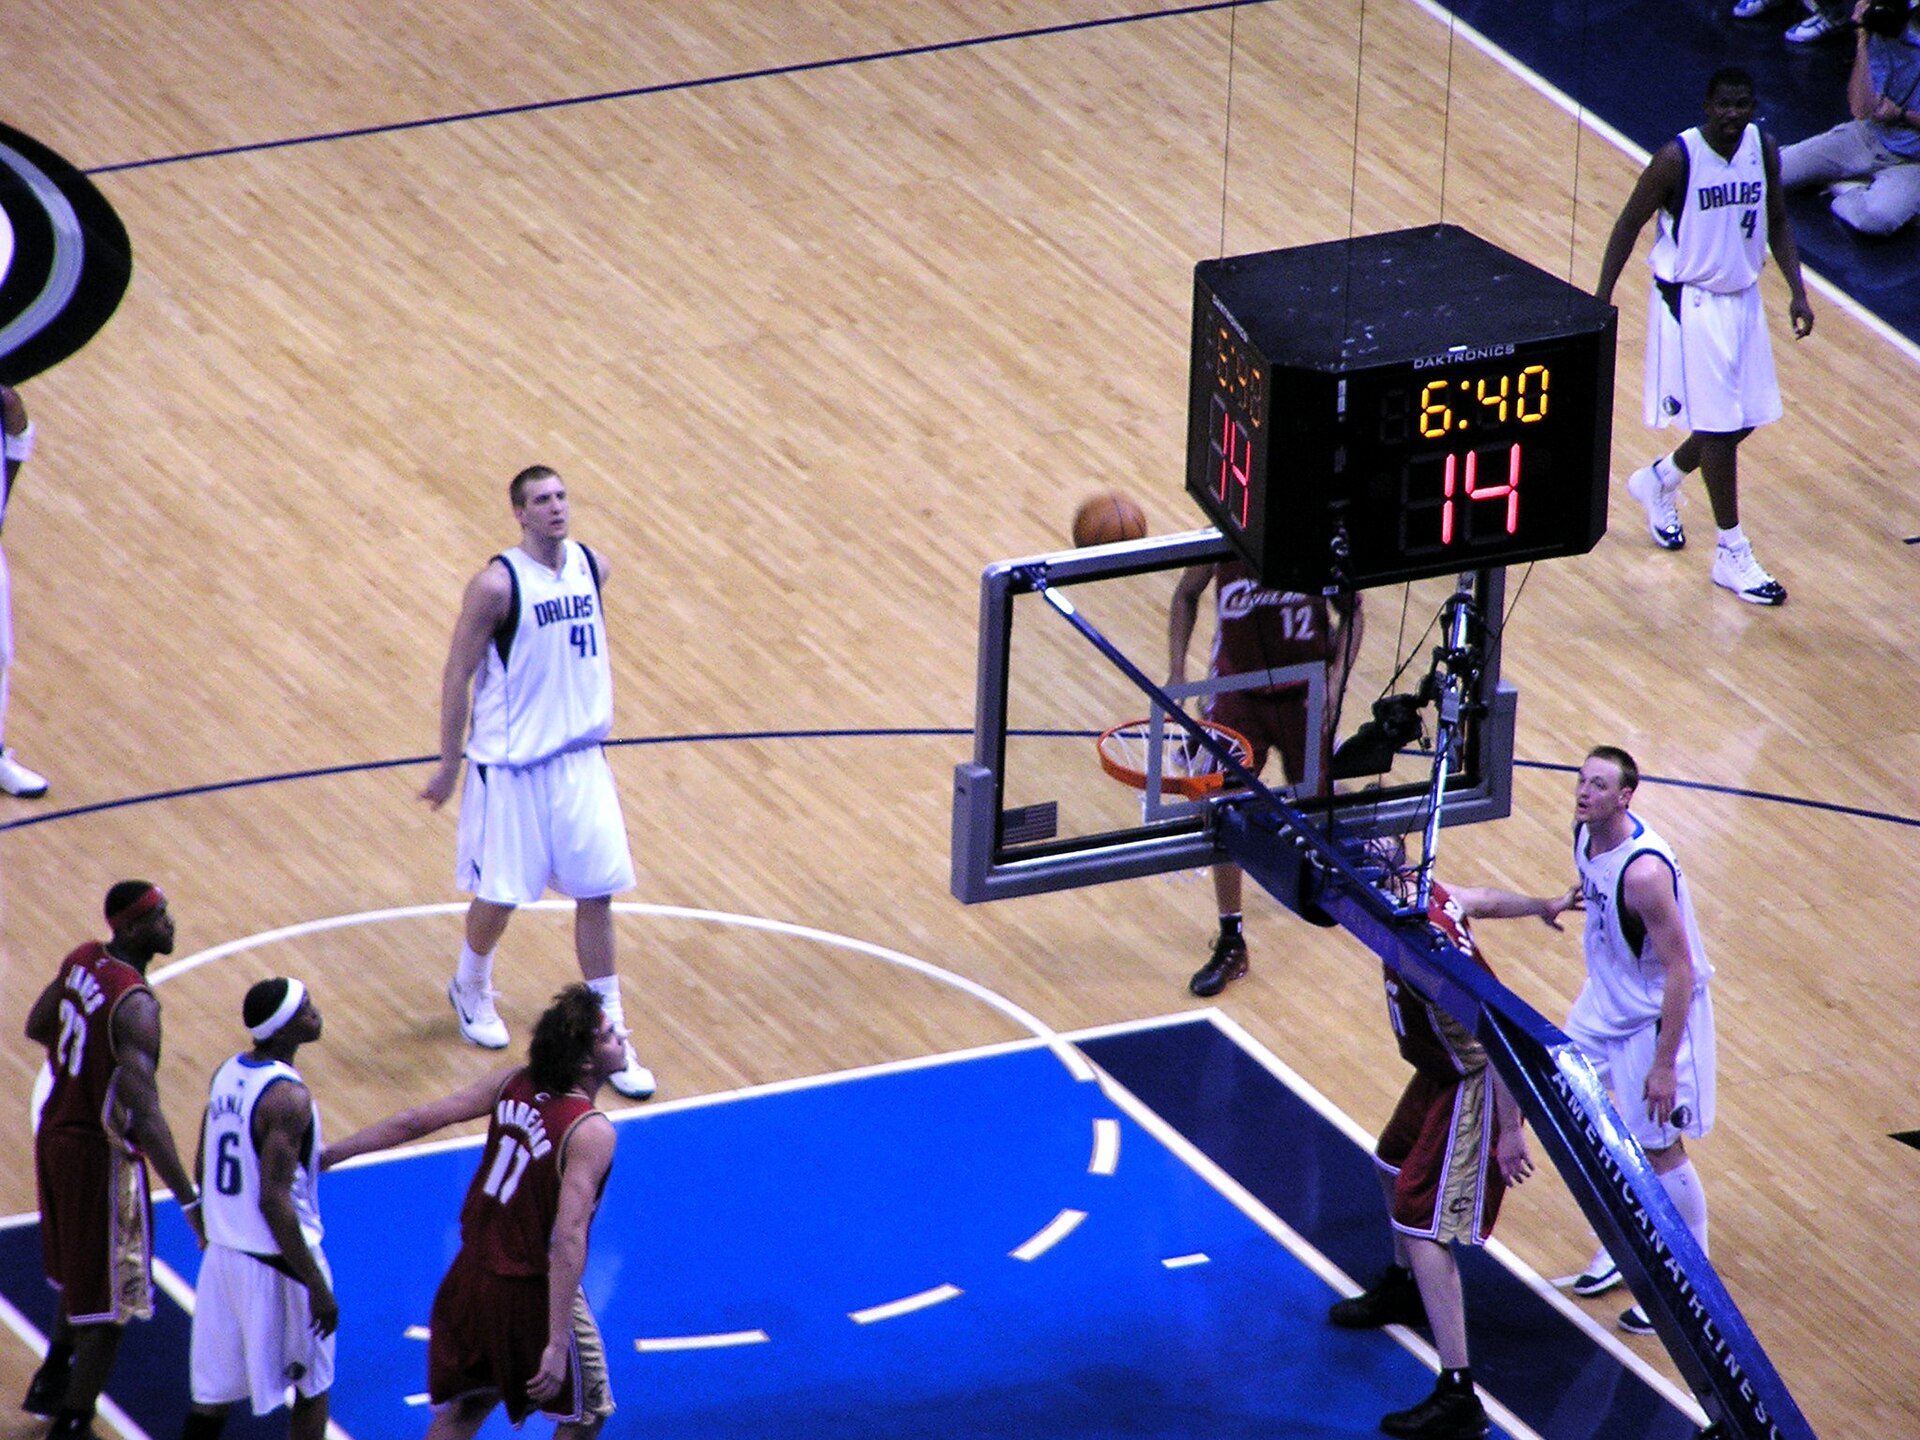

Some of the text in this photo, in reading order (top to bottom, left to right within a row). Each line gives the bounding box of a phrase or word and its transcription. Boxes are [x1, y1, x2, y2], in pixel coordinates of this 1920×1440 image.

[1698, 182, 1761, 211] DALLAS
[1740, 209, 1757, 239] 4
[1413, 343, 1515, 369] DAKTRONICS
[1420, 365, 1549, 438] 6:40
[1442, 443, 1519, 545] 14
[533, 594, 593, 627] DALLAS
[1281, 605, 1314, 640] 12
[570, 623, 597, 658] 41
[217, 1132, 242, 1196] 6
